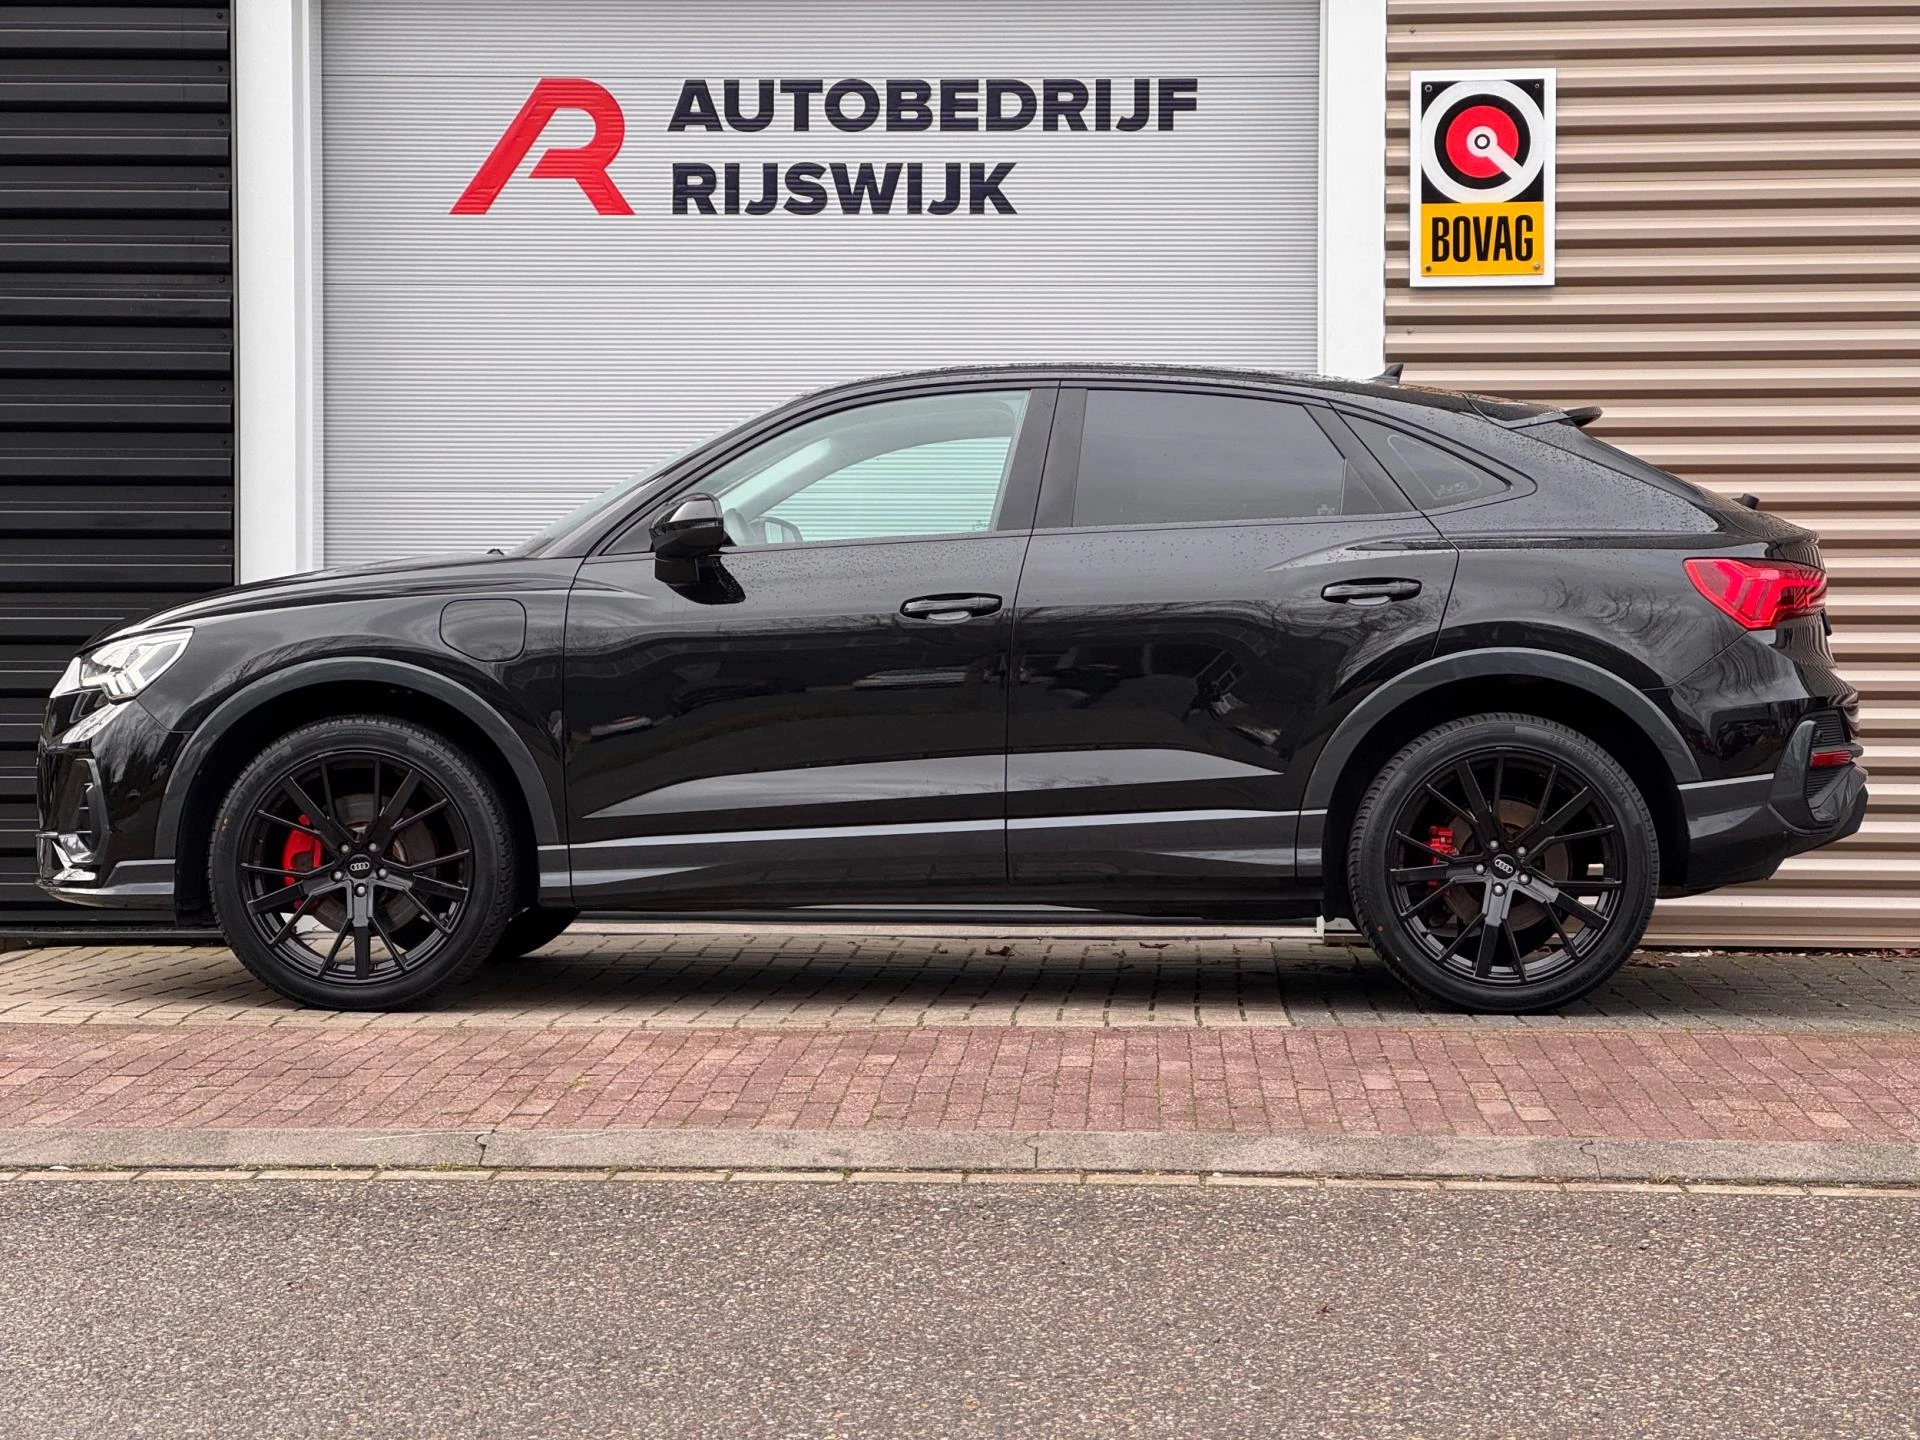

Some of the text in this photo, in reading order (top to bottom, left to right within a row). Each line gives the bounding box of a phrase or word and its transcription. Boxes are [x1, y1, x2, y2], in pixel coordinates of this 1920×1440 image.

[668, 79, 1198, 133] AUTOBEDRIJF
[672, 162, 1017, 215] RIJSWIJK
[1431, 215, 1534, 262] BOVAG
